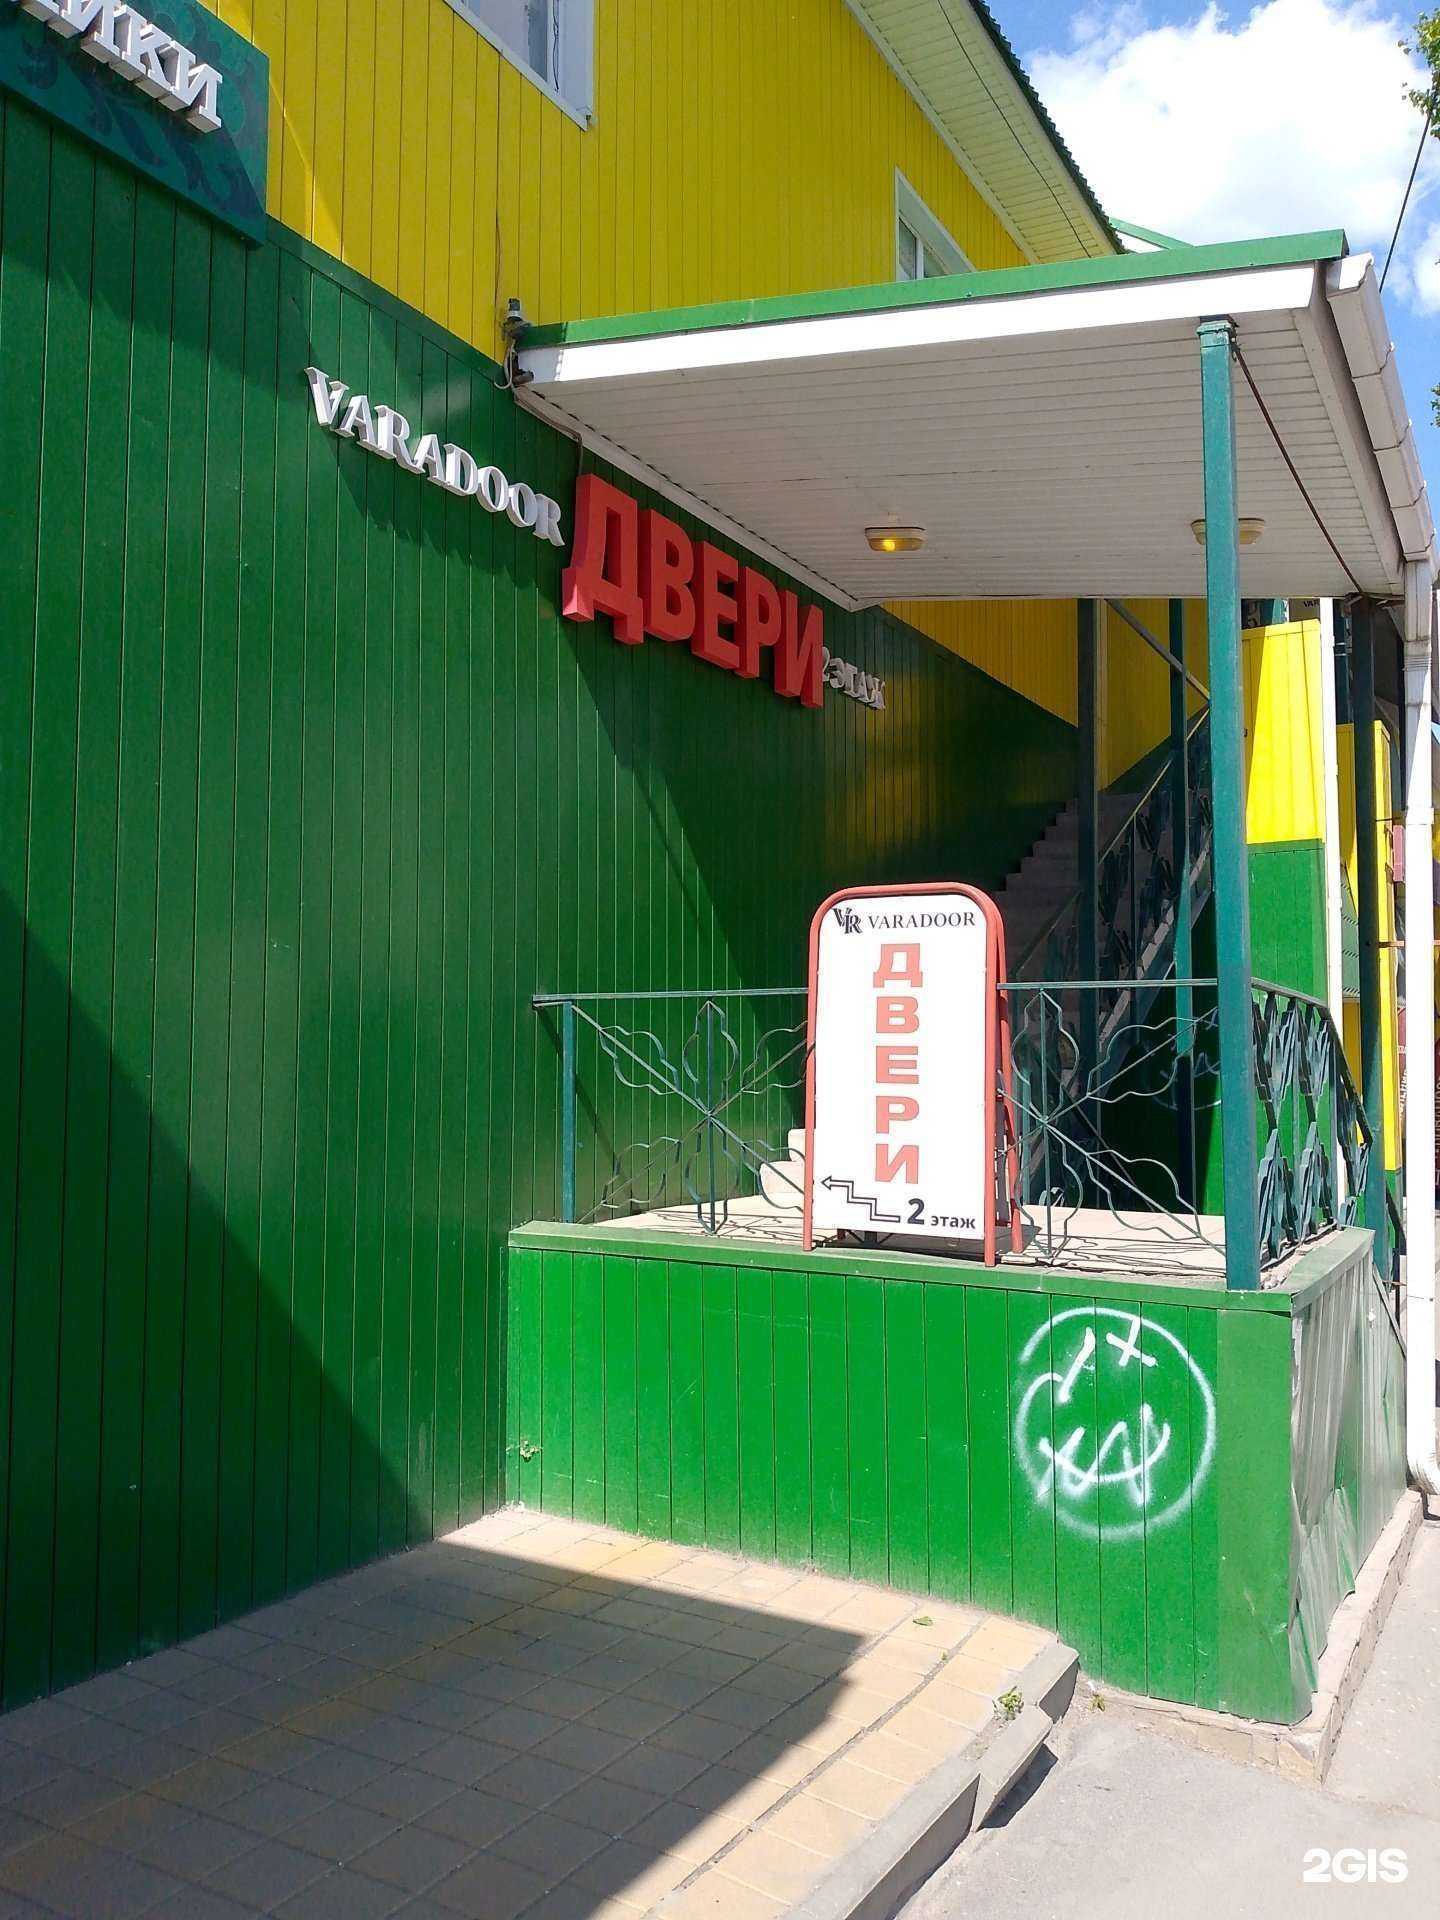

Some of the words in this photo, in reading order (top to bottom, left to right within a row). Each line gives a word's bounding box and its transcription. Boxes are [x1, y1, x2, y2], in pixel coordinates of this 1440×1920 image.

[22, 0, 223, 133] ИКИ
[303, 366, 566, 547] VARADOOR
[562, 472, 824, 709] ДВЕРИ
[867, 911, 976, 930] VARADOOR
[872, 942, 924, 1185] ДВЕРИ
[907, 1197, 925, 1226] 2
[930, 1215, 977, 1230] этаж
